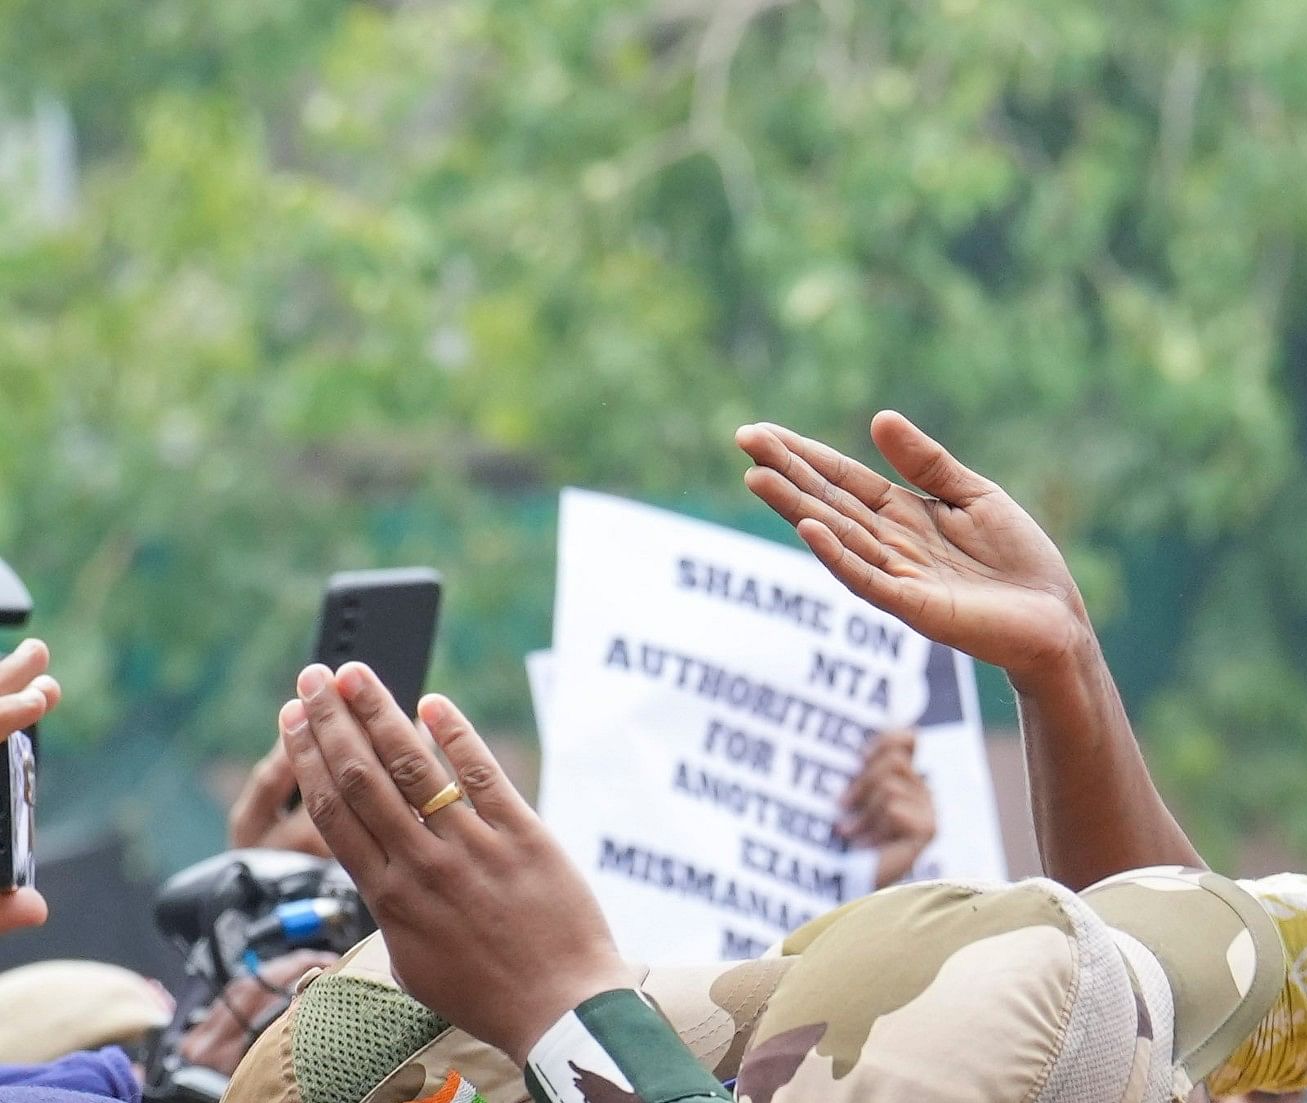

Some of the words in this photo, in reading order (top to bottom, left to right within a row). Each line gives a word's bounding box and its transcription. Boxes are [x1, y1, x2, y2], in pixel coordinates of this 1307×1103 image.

[674, 556, 833, 636] SHAME
[845, 607, 904, 661] ON
[809, 650, 892, 714] NTA
[704, 718, 775, 768] FOR
[791, 752, 855, 799] YE
[741, 835, 846, 904] EXAM
